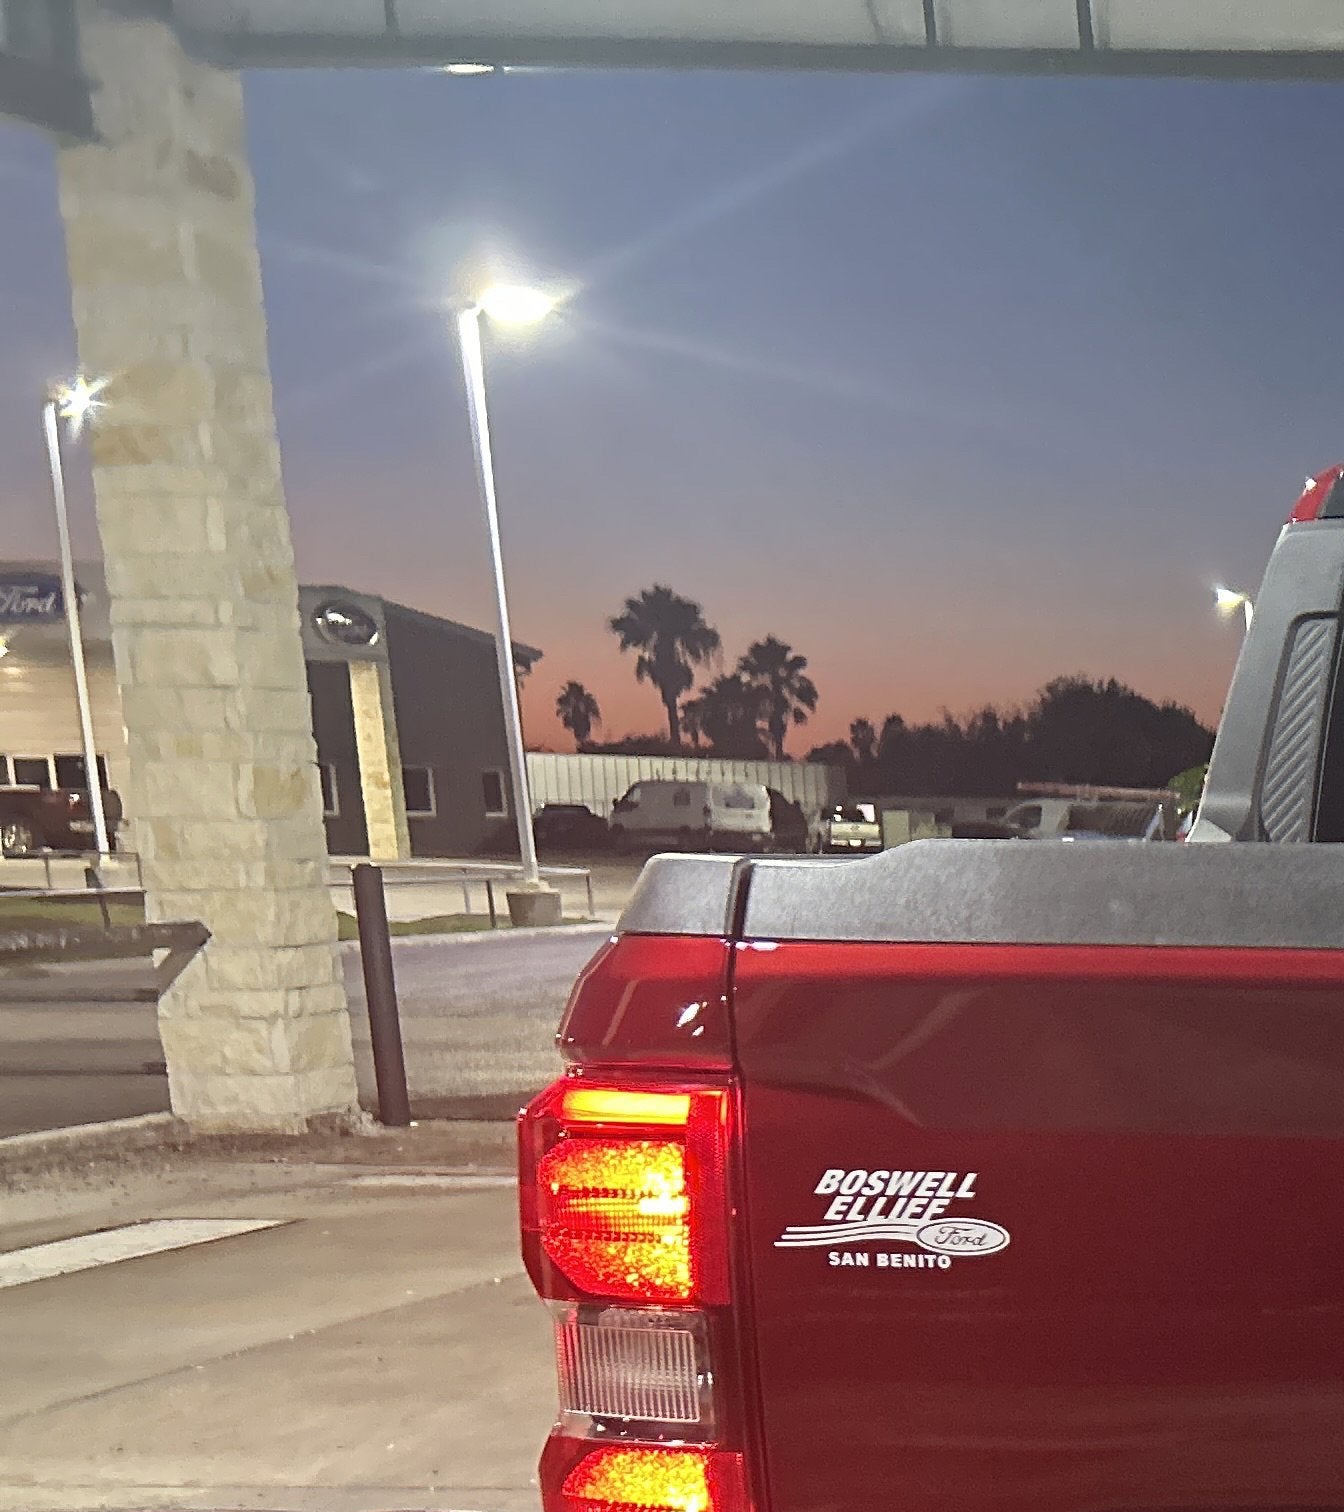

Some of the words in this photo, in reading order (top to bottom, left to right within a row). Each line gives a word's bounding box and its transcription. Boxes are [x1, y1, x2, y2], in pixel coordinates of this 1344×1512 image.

[814, 1169, 978, 1198] BOSWELL
[823, 1196, 952, 1221] ELLIFF
[934, 1225, 987, 1247] Ford
[828, 1252, 868, 1267] SAN
[876, 1253, 951, 1269] BENITO
